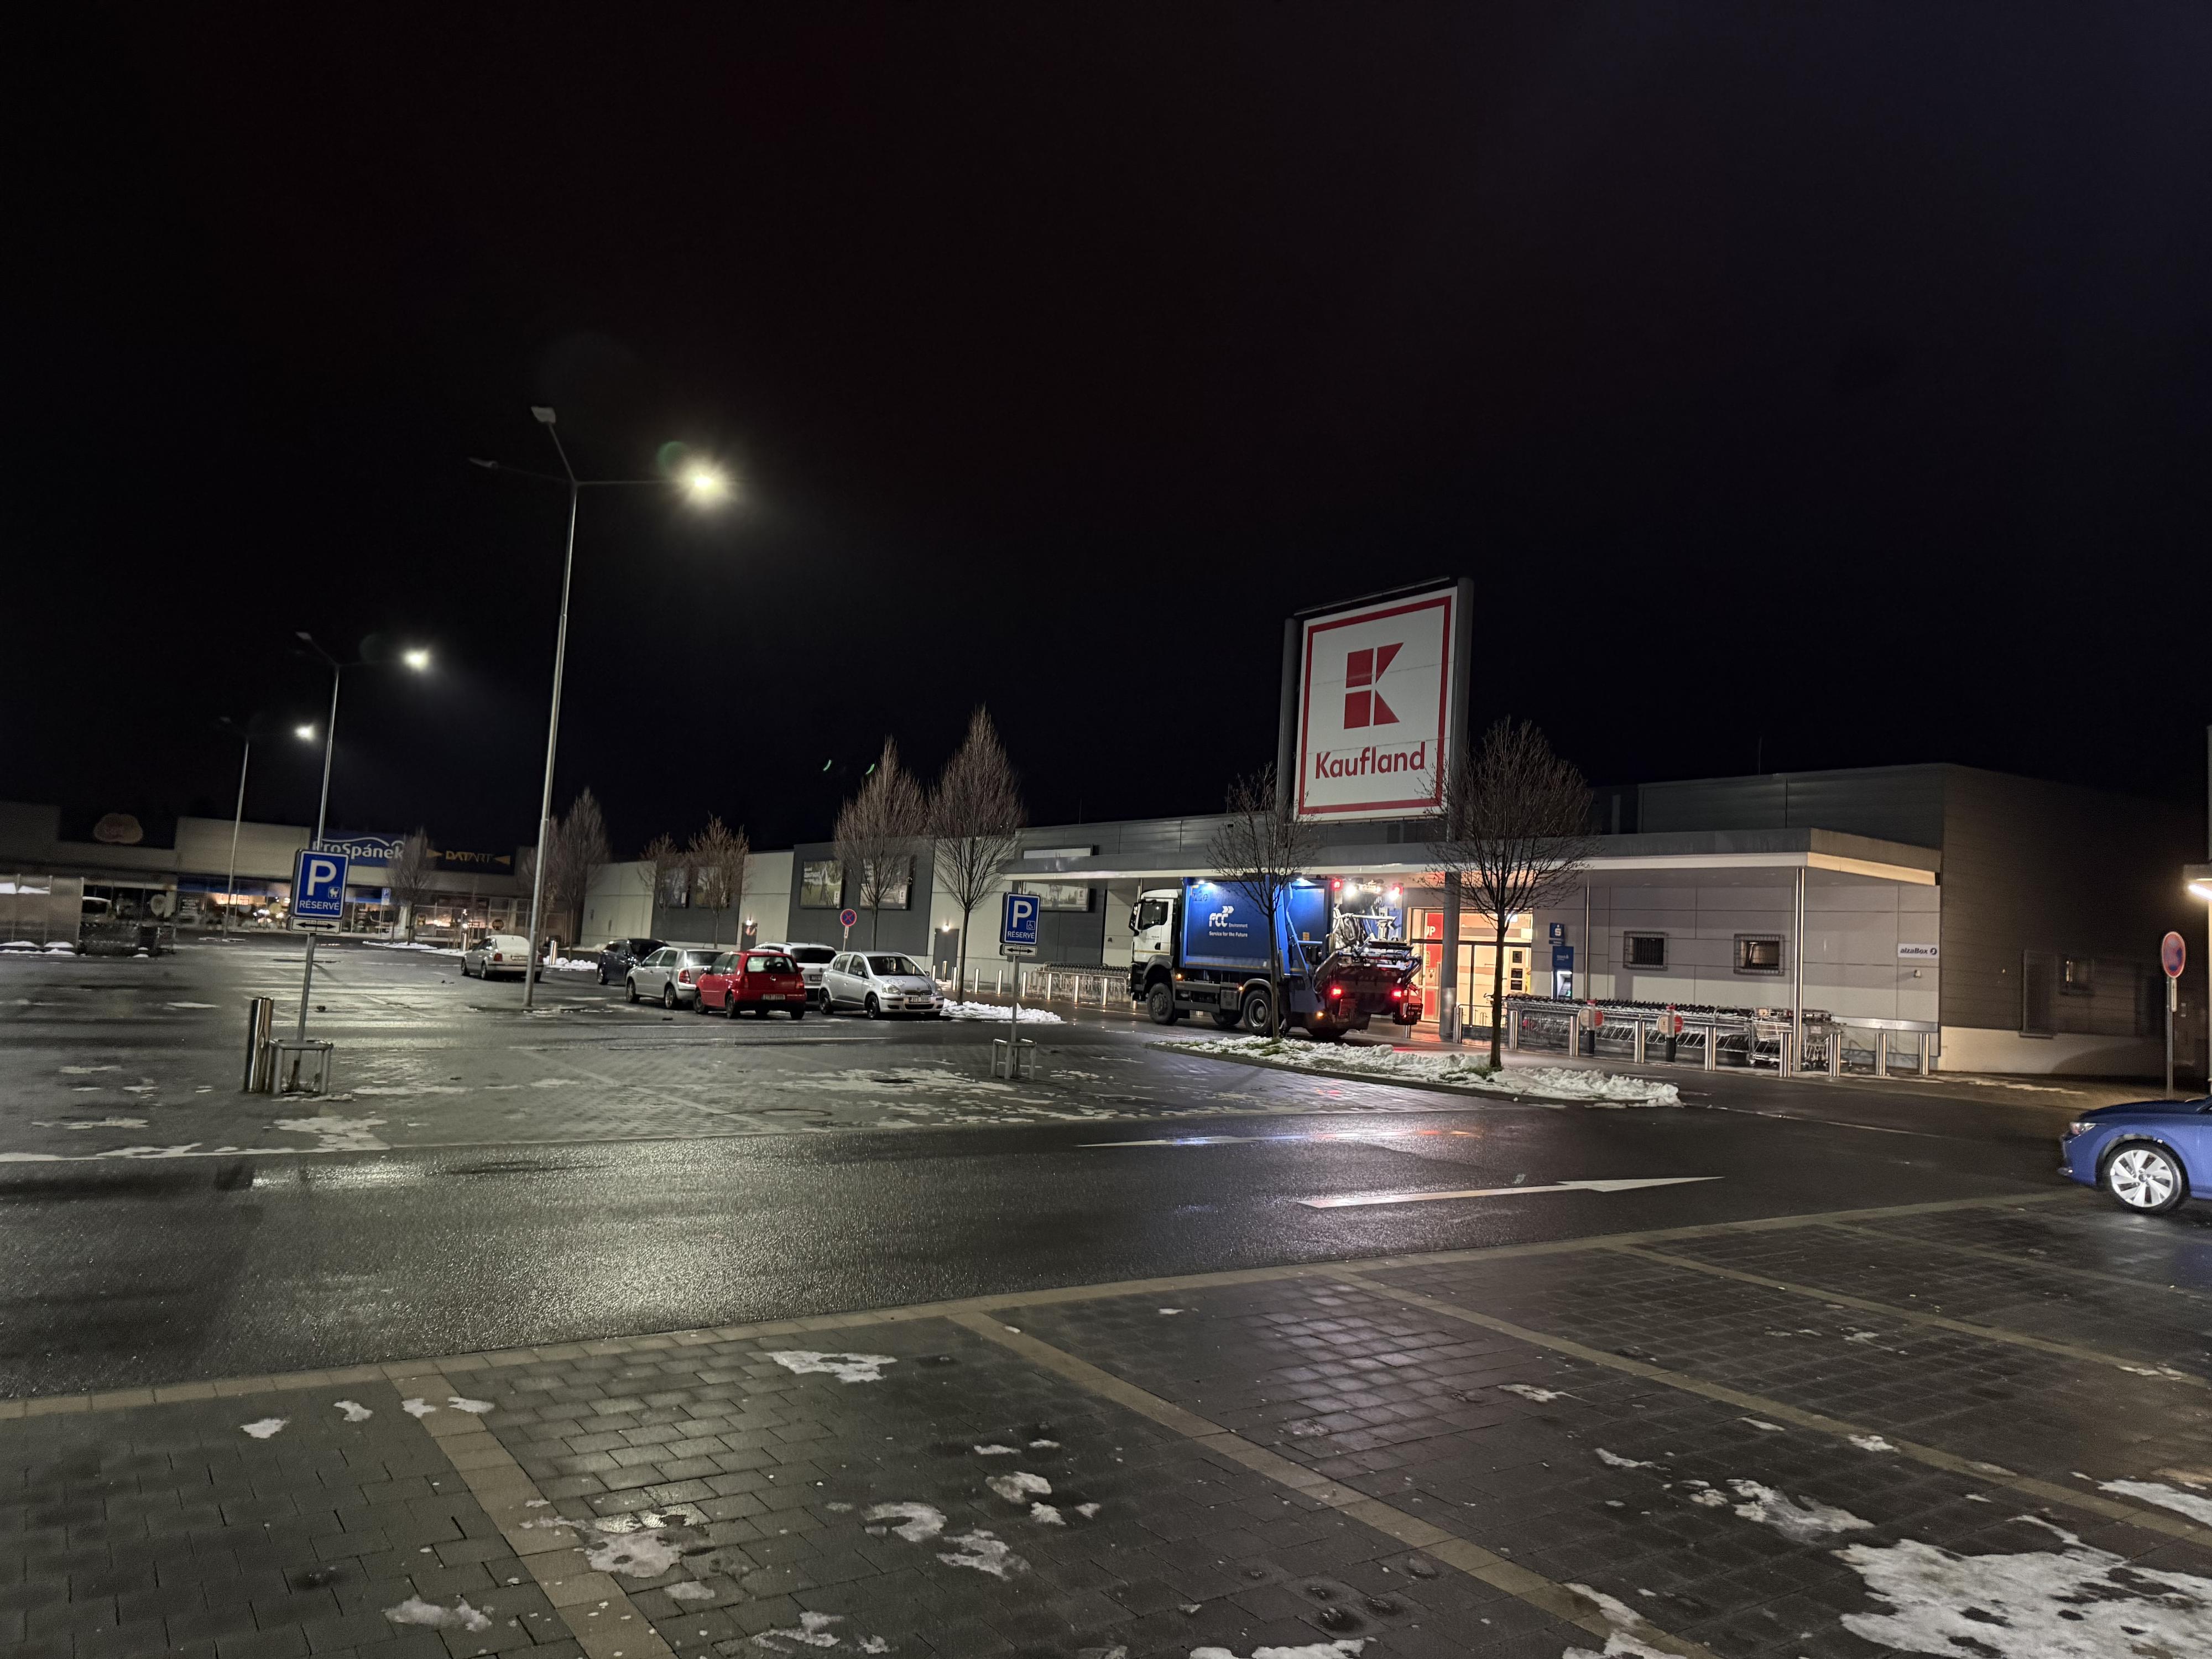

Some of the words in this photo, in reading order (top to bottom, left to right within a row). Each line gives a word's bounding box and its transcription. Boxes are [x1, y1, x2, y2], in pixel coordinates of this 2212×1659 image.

[1316, 741, 1426, 780] Kaufland
[306, 859, 337, 896] P
[299, 899, 340, 911] RÉSERVÉ
[1012, 900, 1032, 928] P
[1007, 930, 1035, 939] RÉSERVÉ
